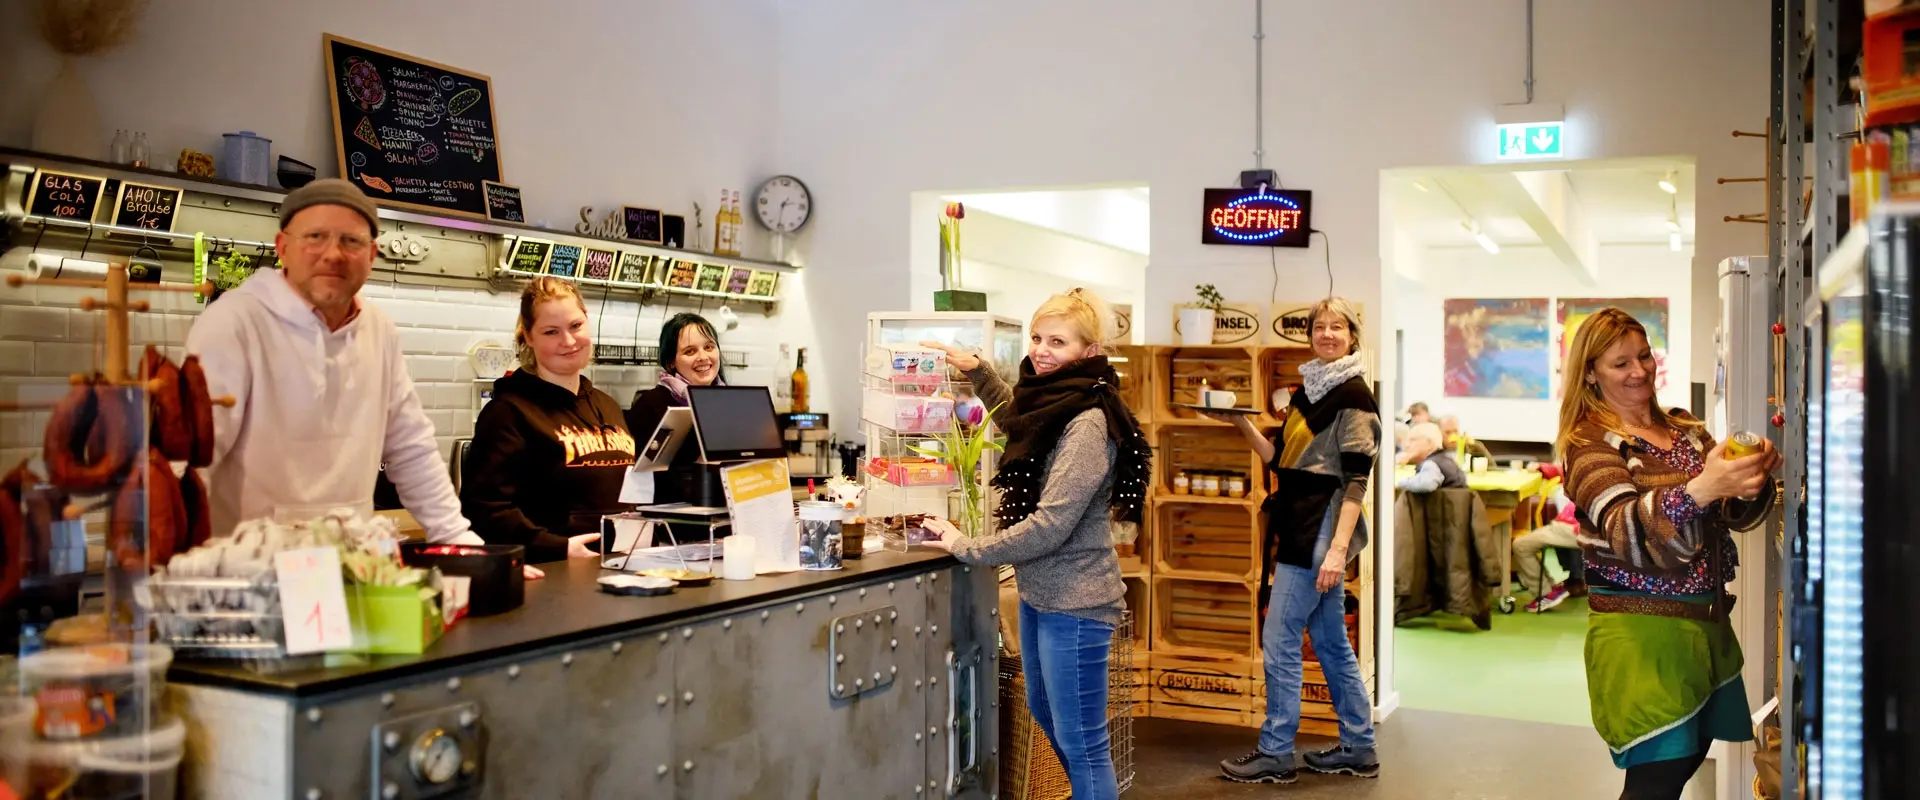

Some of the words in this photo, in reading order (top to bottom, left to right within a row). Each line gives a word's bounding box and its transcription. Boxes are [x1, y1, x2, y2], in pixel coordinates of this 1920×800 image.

[398, 108, 425, 119] SPINAT
[399, 116, 425, 128] TONNO
[450, 116, 486, 129] BAGUETTE
[384, 140, 412, 150] HAWAII
[387, 152, 418, 165] SALAMI
[45, 176, 83, 191] GLAS
[443, 181, 475, 191] CESTINO
[49, 191, 85, 204] COLA
[126, 202, 171, 215] Brause
[575, 206, 628, 240] Smile
[1210, 204, 1301, 229] GEÖFFNET
[522, 243, 540, 254] TEE
[587, 250, 612, 266] KAKAO
[1215, 316, 1252, 329] INSEL
[1282, 317, 1308, 329] BRO
[1167, 674, 1237, 693] BROTINSEL
